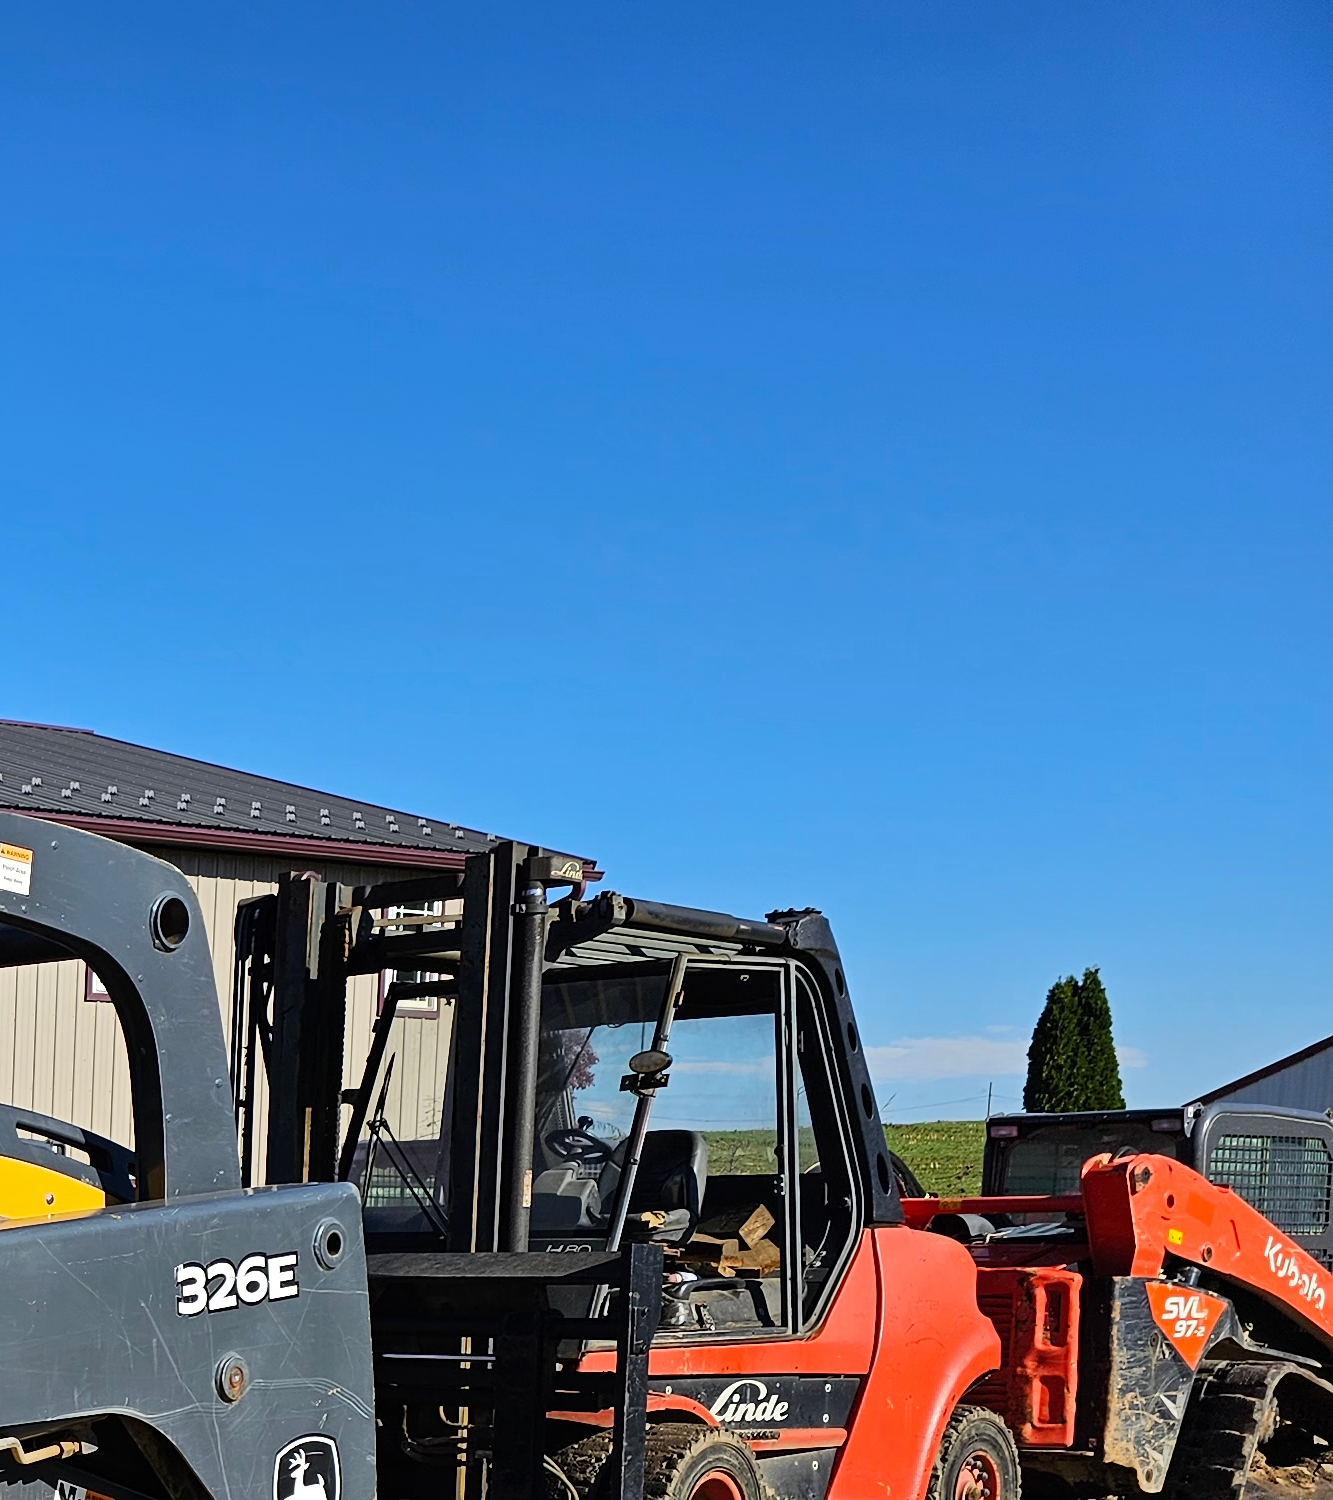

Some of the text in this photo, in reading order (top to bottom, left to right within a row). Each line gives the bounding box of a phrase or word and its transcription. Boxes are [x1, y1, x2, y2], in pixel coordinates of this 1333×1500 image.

[550, 861, 583, 880] Lind
[175, 1252, 299, 1316] 326E
[1264, 1235, 1326, 1311] Kubota
[1161, 1295, 1209, 1320] SVL
[1172, 1319, 1206, 1338] 97-2
[709, 1379, 789, 1422] Linde
